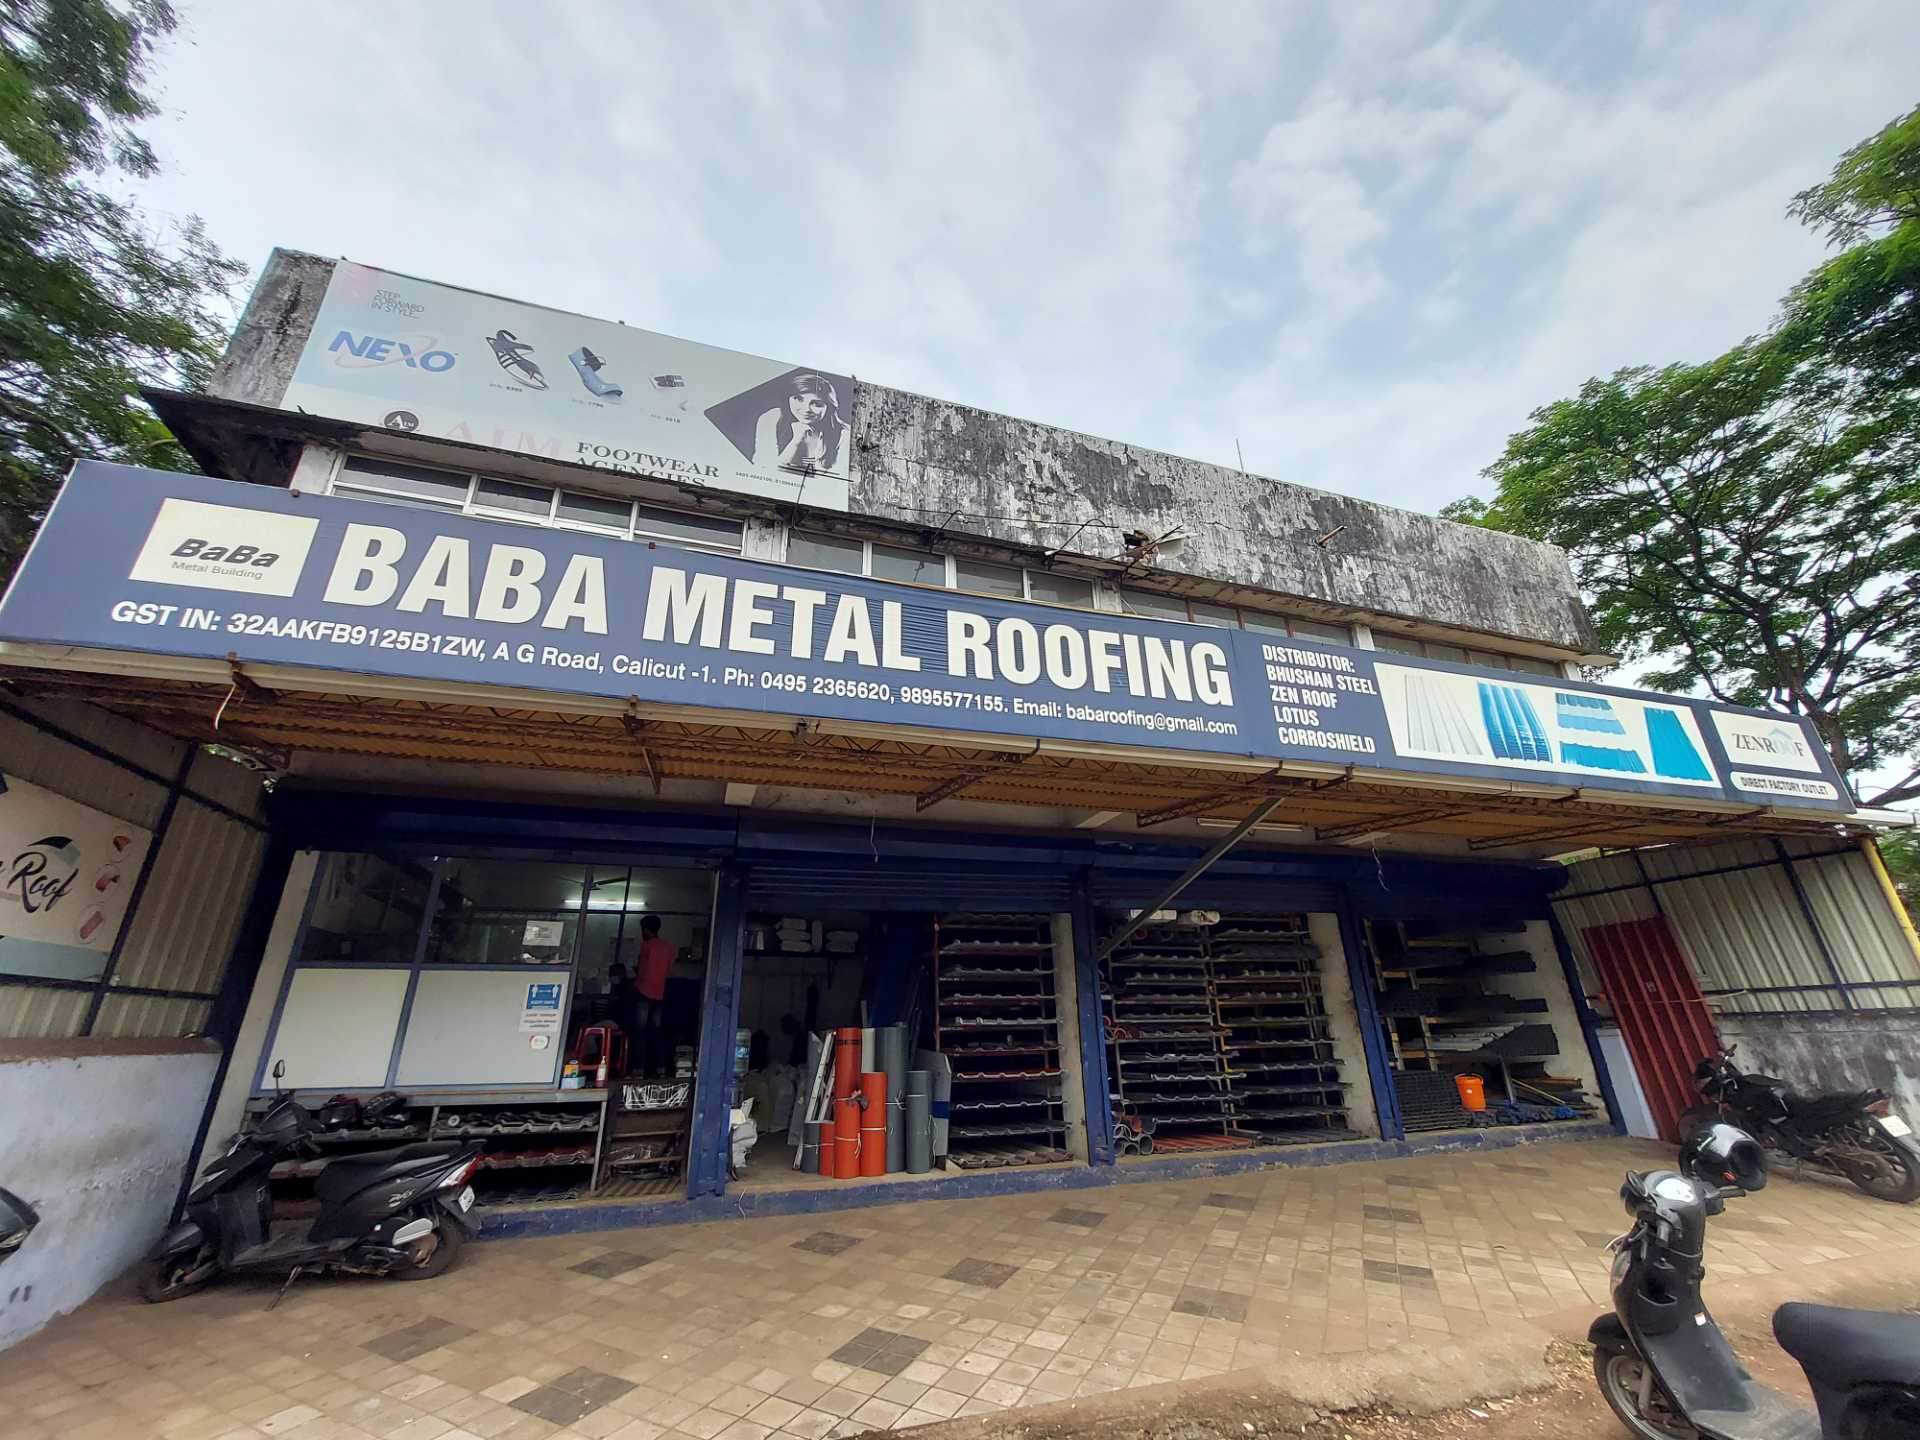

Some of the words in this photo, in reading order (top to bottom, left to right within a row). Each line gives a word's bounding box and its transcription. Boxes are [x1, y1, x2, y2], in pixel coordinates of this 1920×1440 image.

[327, 330, 457, 373] NEXO
[576, 441, 720, 478] FOOTWEAR
[170, 537, 280, 568] BaBa
[171, 560, 209, 573] Metal
[211, 565, 264, 580] Building
[322, 522, 608, 636] BABA
[642, 566, 921, 672] METAL
[946, 609, 1234, 707] ROOFING
[111, 601, 178, 626] GST
[178, 607, 222, 631] IN:
[493, 641, 509, 661] A
[516, 643, 535, 663] G
[541, 646, 604, 674] Road,
[612, 654, 686, 681] Calicut
[691, 665, 716, 683] -1.
[723, 667, 754, 688] Ph:
[760, 672, 807, 692] 0495
[813, 677, 895, 705] 2365620,
[901, 686, 1009, 713] 9895577155.
[1013, 698, 1062, 718] Email:
[1066, 703, 1238, 735] babaroofing@gmail.com
[1262, 644, 1355, 673] DISTRIBUTOR:
[1265, 664, 1334, 689] BHUSHAN
[1336, 674, 1378, 695] STEEL
[1269, 684, 1300, 704] ZEN
[1301, 689, 1338, 709] ROOF
[1273, 705, 1320, 726] LOTUS
[1278, 727, 1376, 754] CORROSHIELD
[1740, 776, 1768, 789] DIRECT
[1768, 779, 1802, 793] FACTORY
[1802, 783, 1829, 796] OUTLET
[6, 851, 79, 914] Roof
